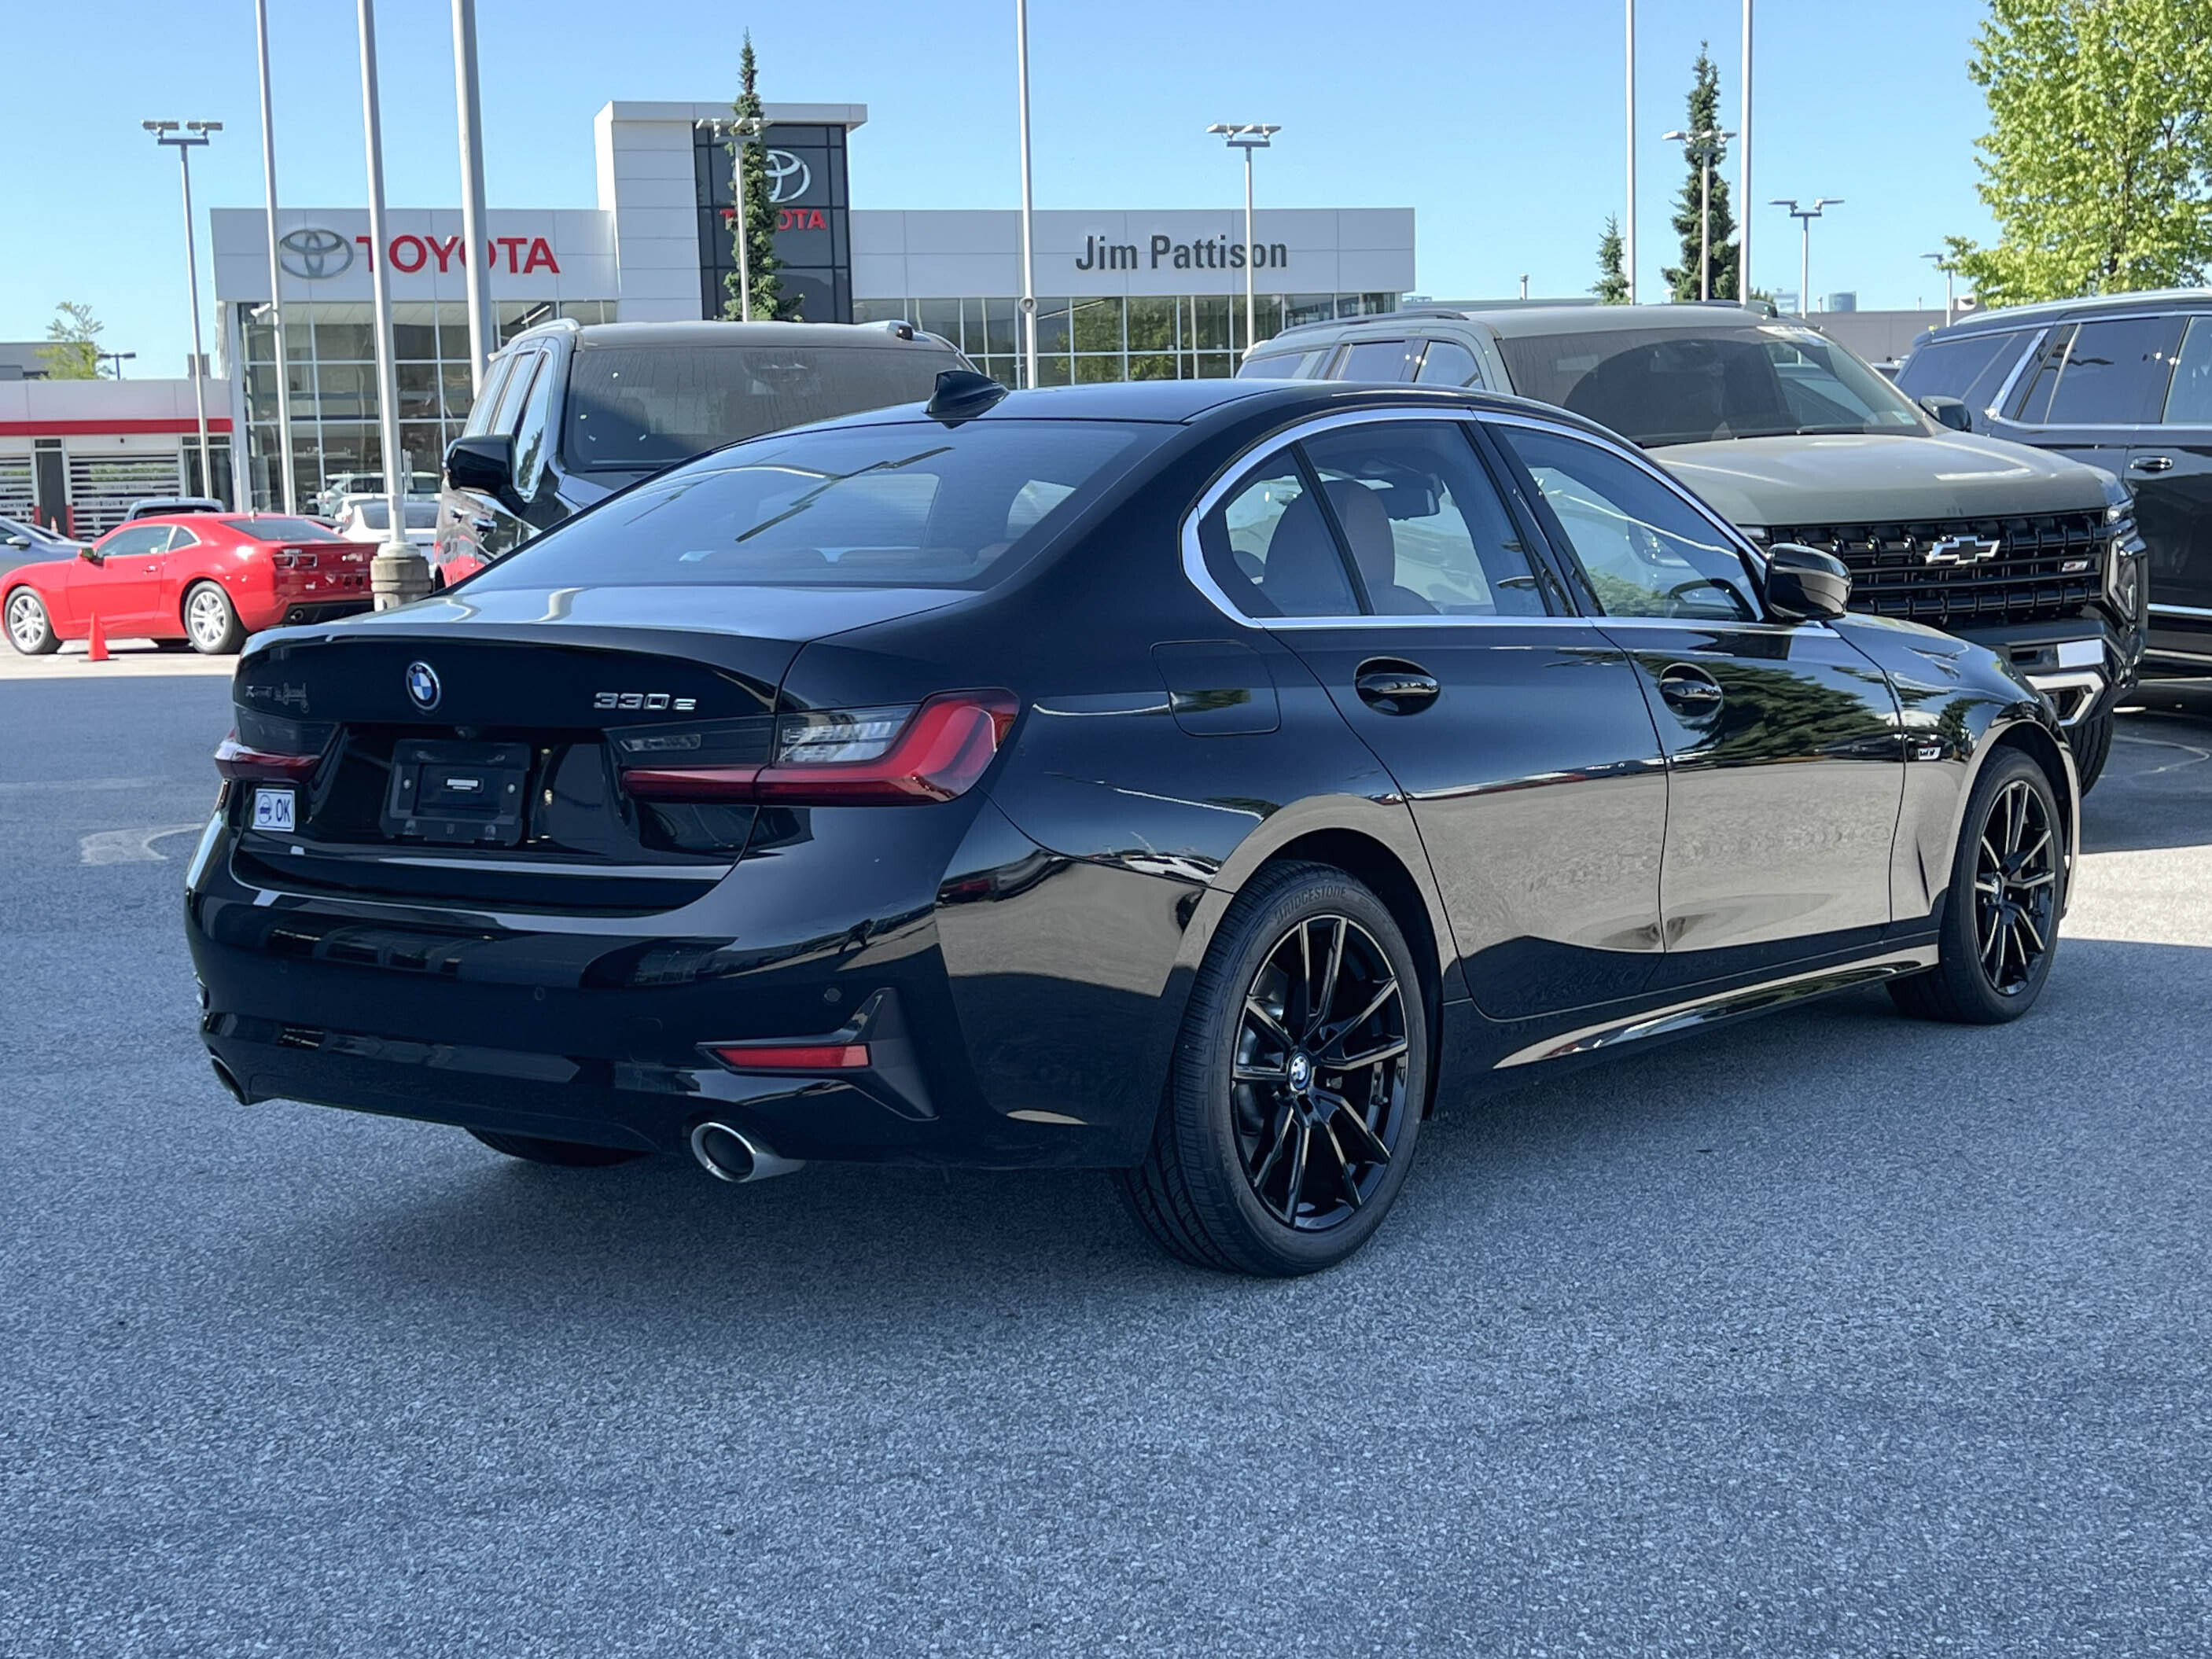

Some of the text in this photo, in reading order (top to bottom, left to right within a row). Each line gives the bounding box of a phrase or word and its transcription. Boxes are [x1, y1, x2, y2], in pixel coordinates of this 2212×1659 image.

[720, 208, 826, 230] TOTA
[1076, 234, 1287, 270] Jim Pattison
[276, 798, 291, 822] OK
